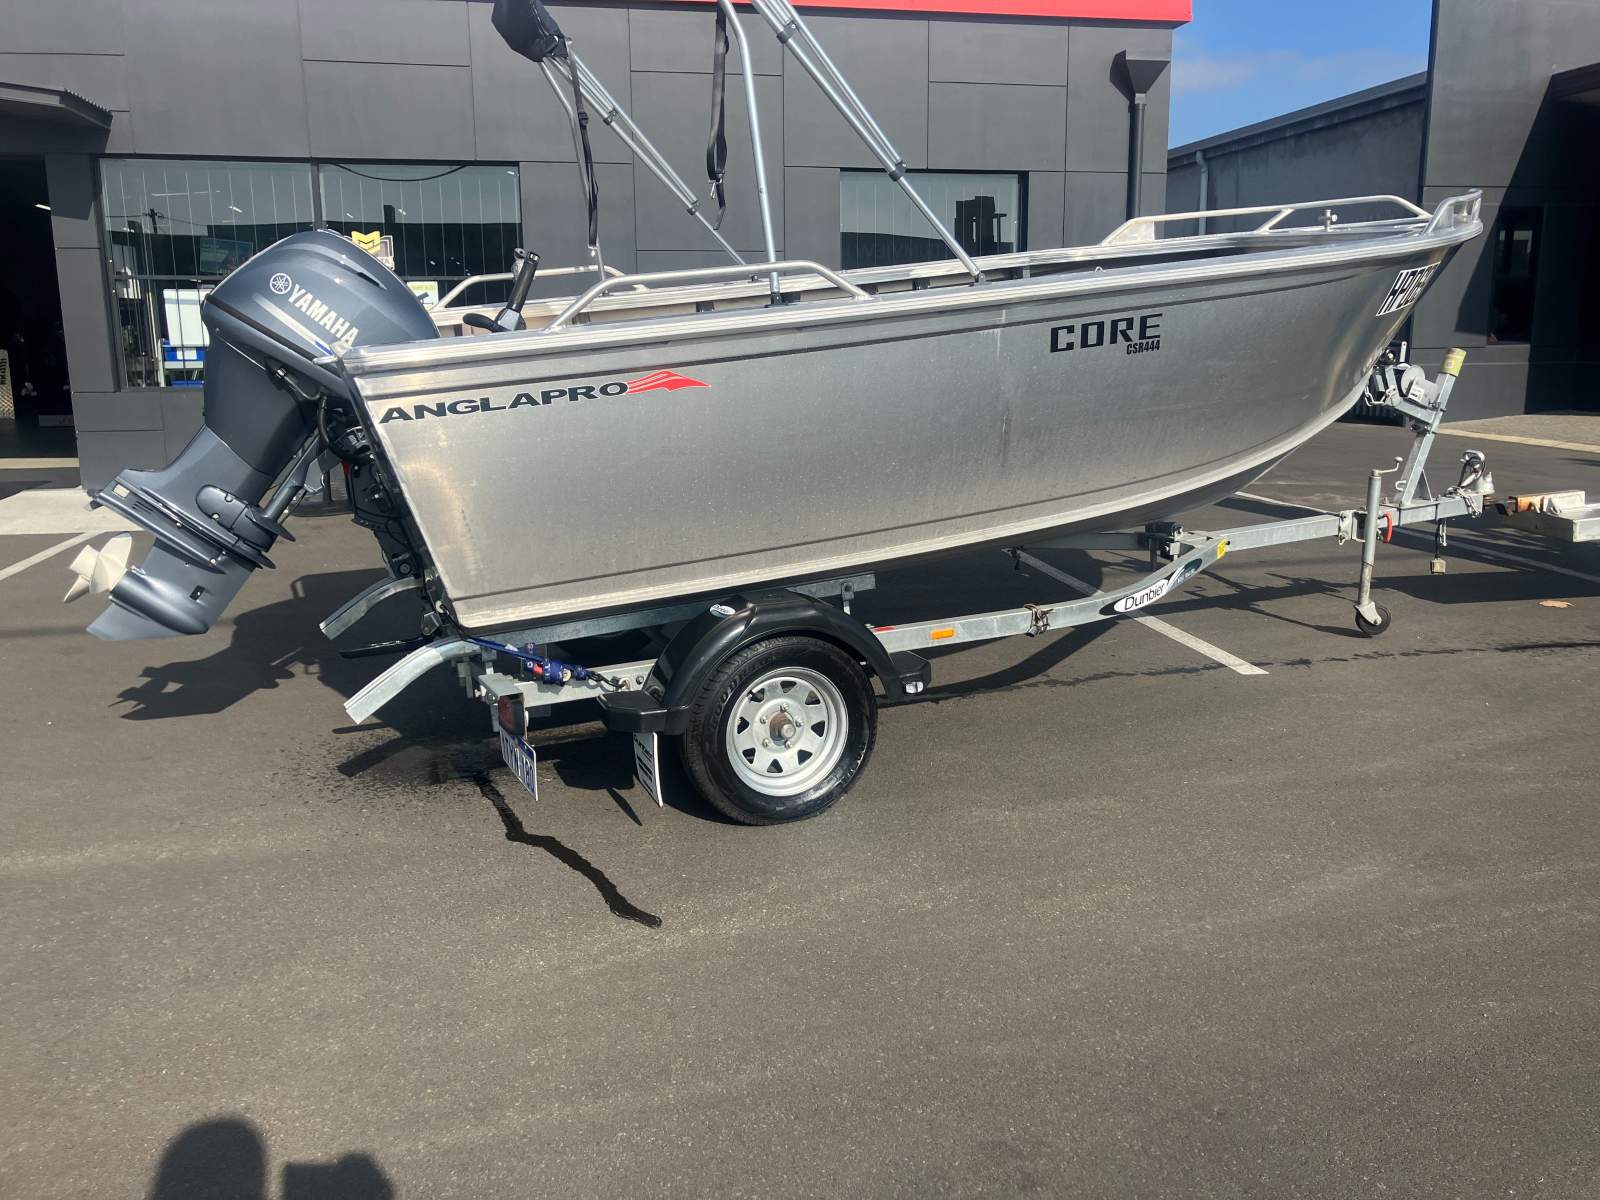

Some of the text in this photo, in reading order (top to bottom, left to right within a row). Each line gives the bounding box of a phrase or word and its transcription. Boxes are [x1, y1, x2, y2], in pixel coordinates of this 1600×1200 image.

[288, 283, 359, 346] YAMAHA
[1050, 313, 1163, 353] CORE
[1126, 339, 1161, 355] CSR444
[378, 382, 629, 424] ANGLAPRO
[1124, 583, 1165, 611] Dunbier
